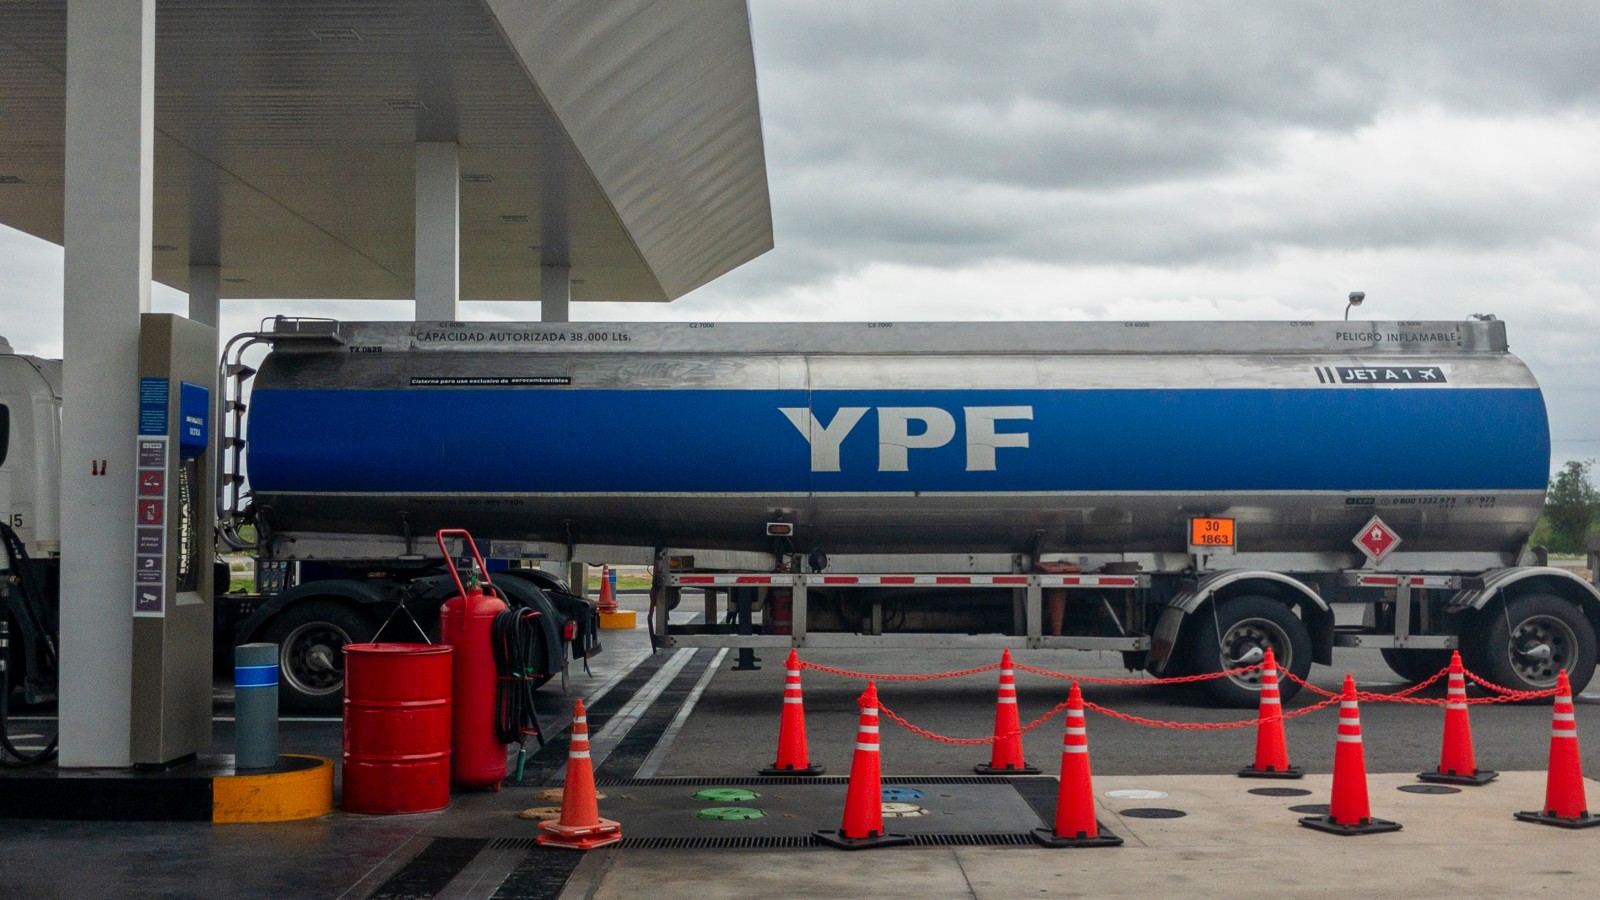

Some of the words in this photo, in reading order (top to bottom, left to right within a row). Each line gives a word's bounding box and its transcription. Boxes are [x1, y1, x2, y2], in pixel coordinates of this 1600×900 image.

[416, 332, 484, 342] CAPACIDAD
[489, 332, 566, 342] AUTORIZADA
[570, 332, 608, 342] 38.000
[612, 332, 632, 342] Lts.
[1336, 332, 1382, 342] PELIGRO
[1387, 332, 1456, 342] INFLAMABLE
[1345, 369, 1379, 381] JET
[1385, 369, 1400, 380] A
[1402, 368, 1413, 380] 1
[777, 405, 1034, 472] YPF
[1205, 520, 1219, 531] 30
[180, 503, 188, 574] INFINIA
[1201, 534, 1229, 544] 1863
